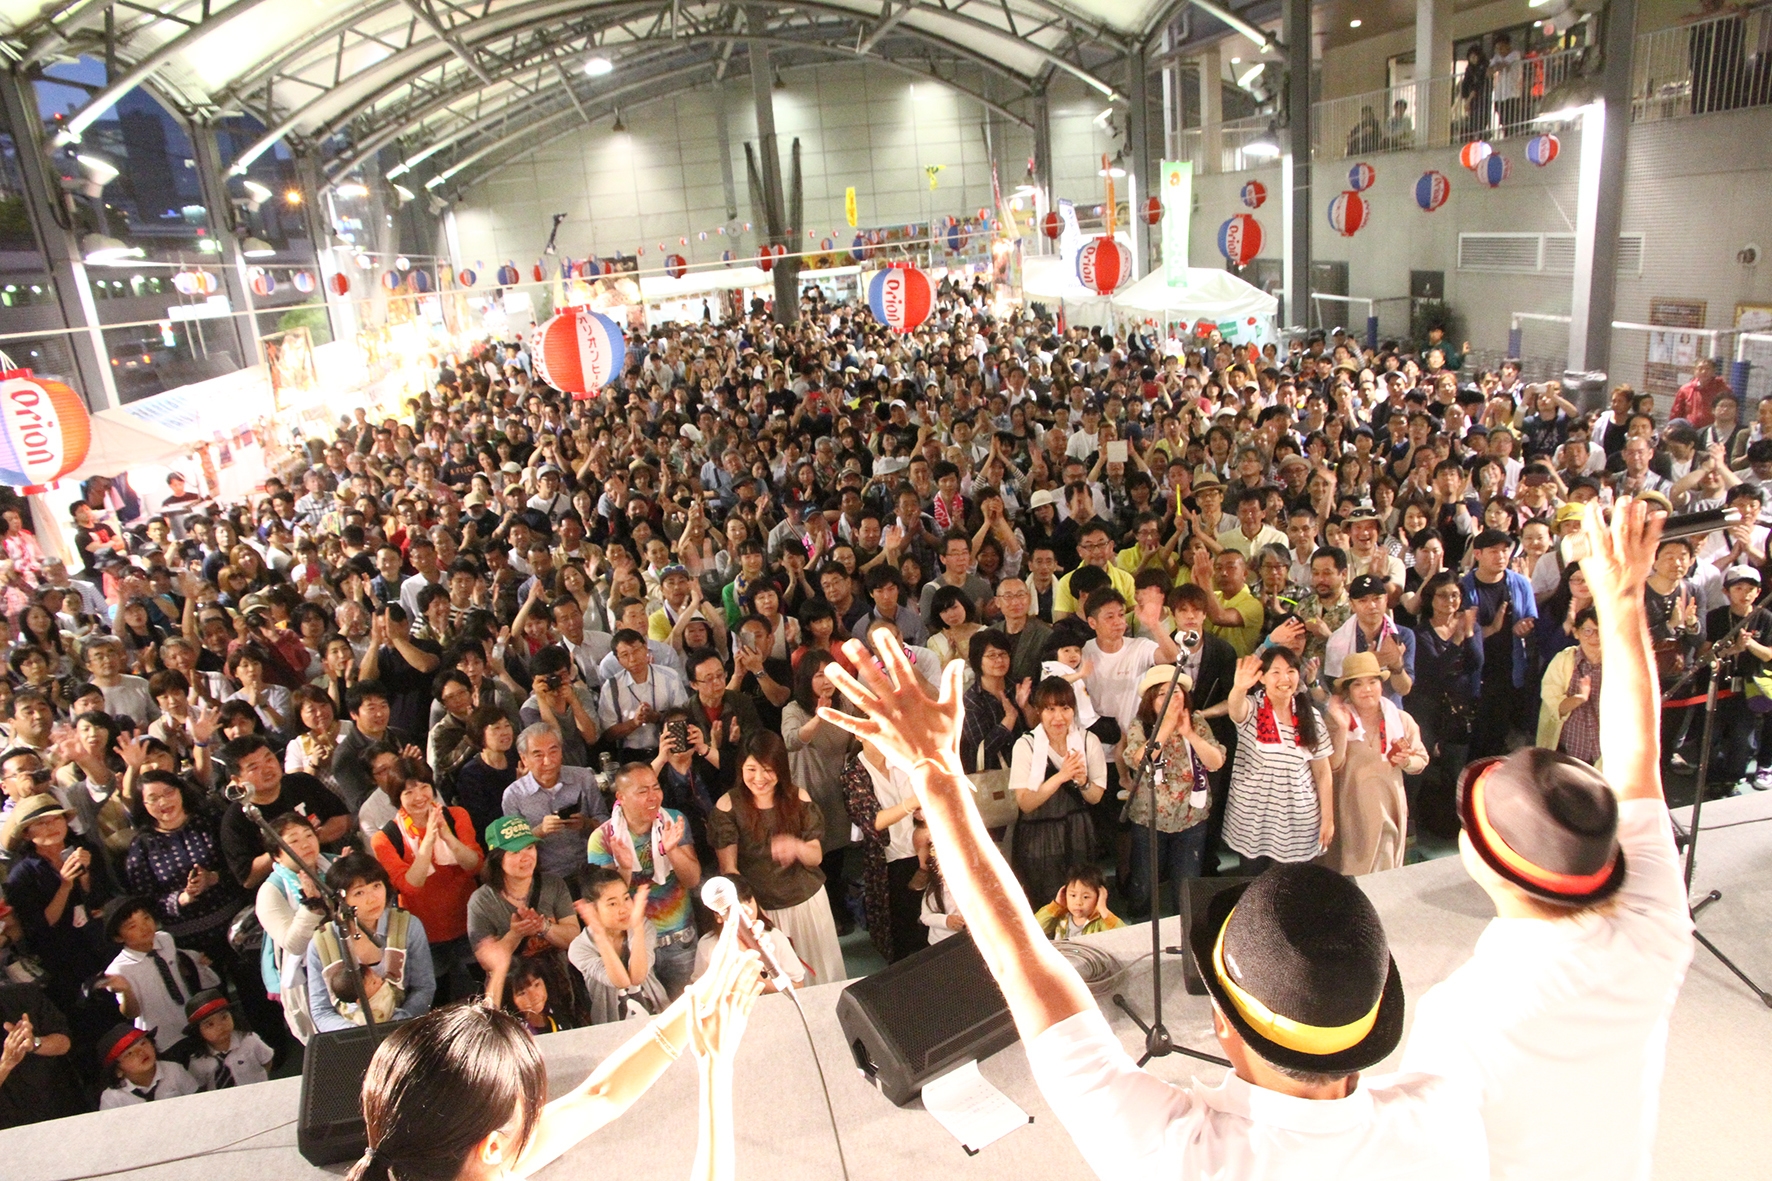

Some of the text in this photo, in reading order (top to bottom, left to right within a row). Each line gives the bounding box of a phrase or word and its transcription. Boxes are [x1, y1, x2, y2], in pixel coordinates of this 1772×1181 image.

[1228, 225, 1240, 257] Orion
[1083, 246, 1096, 283] Orion
[886, 280, 902, 321] Orion
[10, 389, 54, 465] Orion
